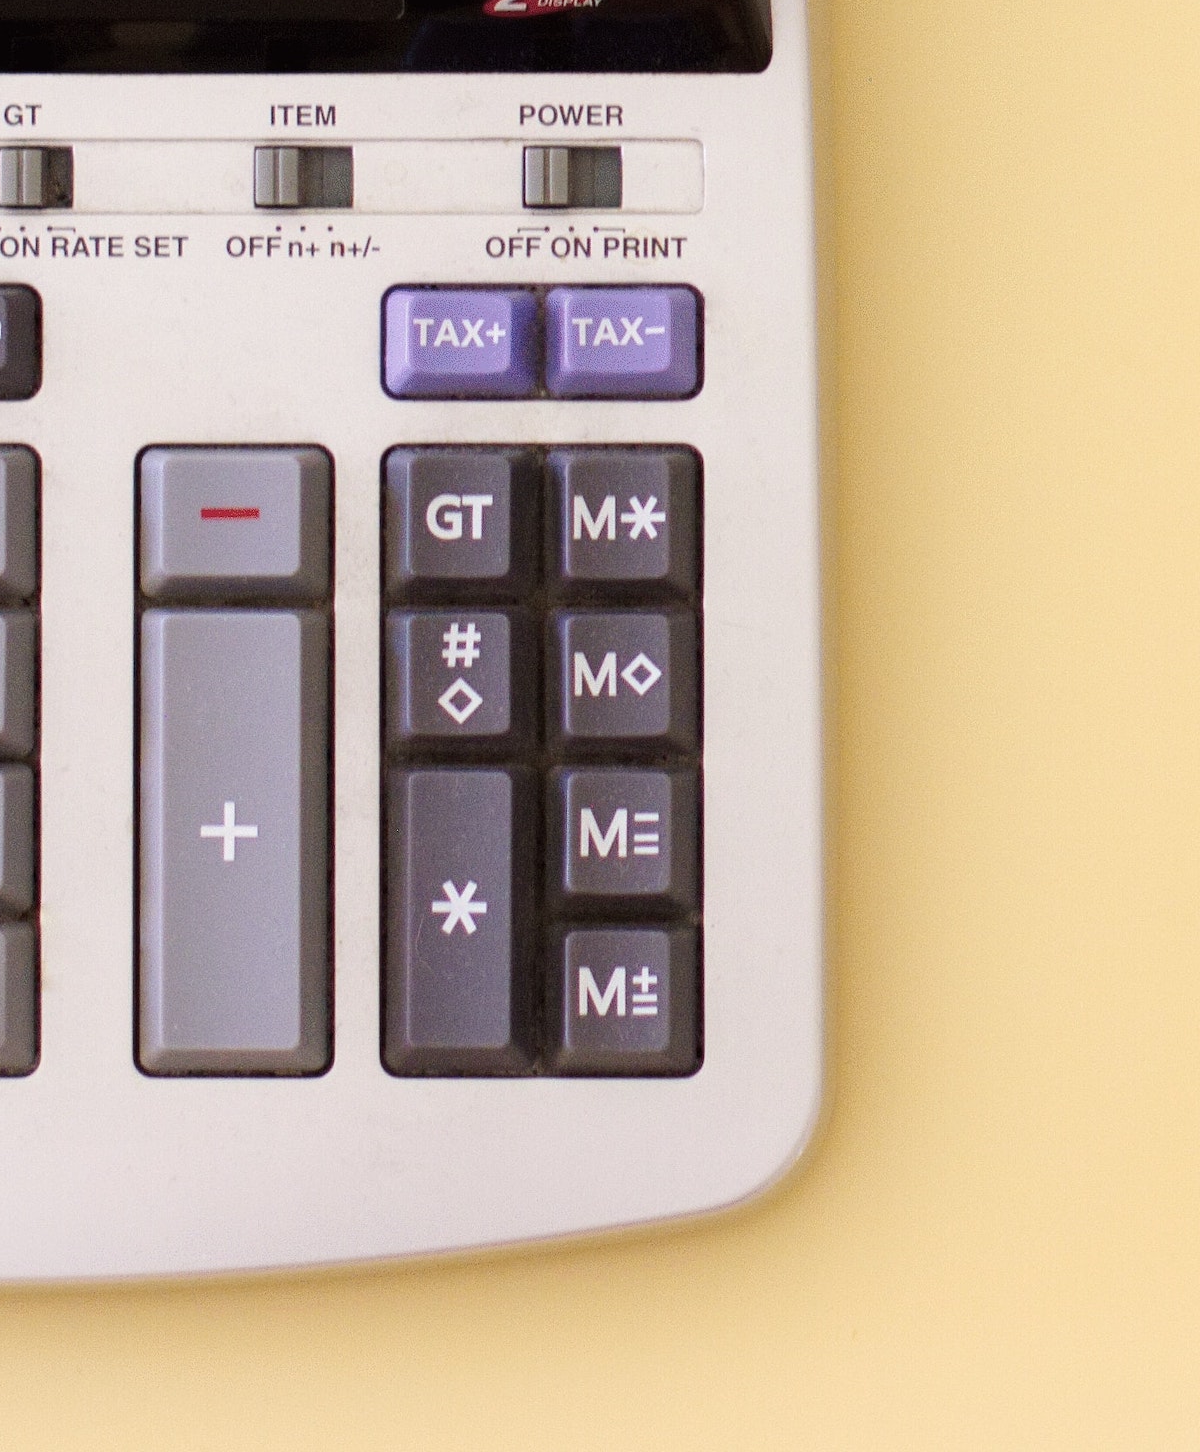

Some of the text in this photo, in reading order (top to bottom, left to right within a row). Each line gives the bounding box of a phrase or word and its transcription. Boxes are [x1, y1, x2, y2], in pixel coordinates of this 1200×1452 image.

[3, 103, 42, 127] GT
[270, 104, 336, 127] ITEM
[519, 104, 624, 127] POWER
[0, 235, 40, 258] ON
[51, 236, 124, 258] RATE
[134, 235, 189, 258] SET
[225, 235, 380, 258] OFF n+ n+/-
[485, 236, 687, 259] OFF ON PRINT
[412, 318, 507, 348] TAX+
[571, 316, 666, 346] TAX-
[426, 494, 494, 540] GT
